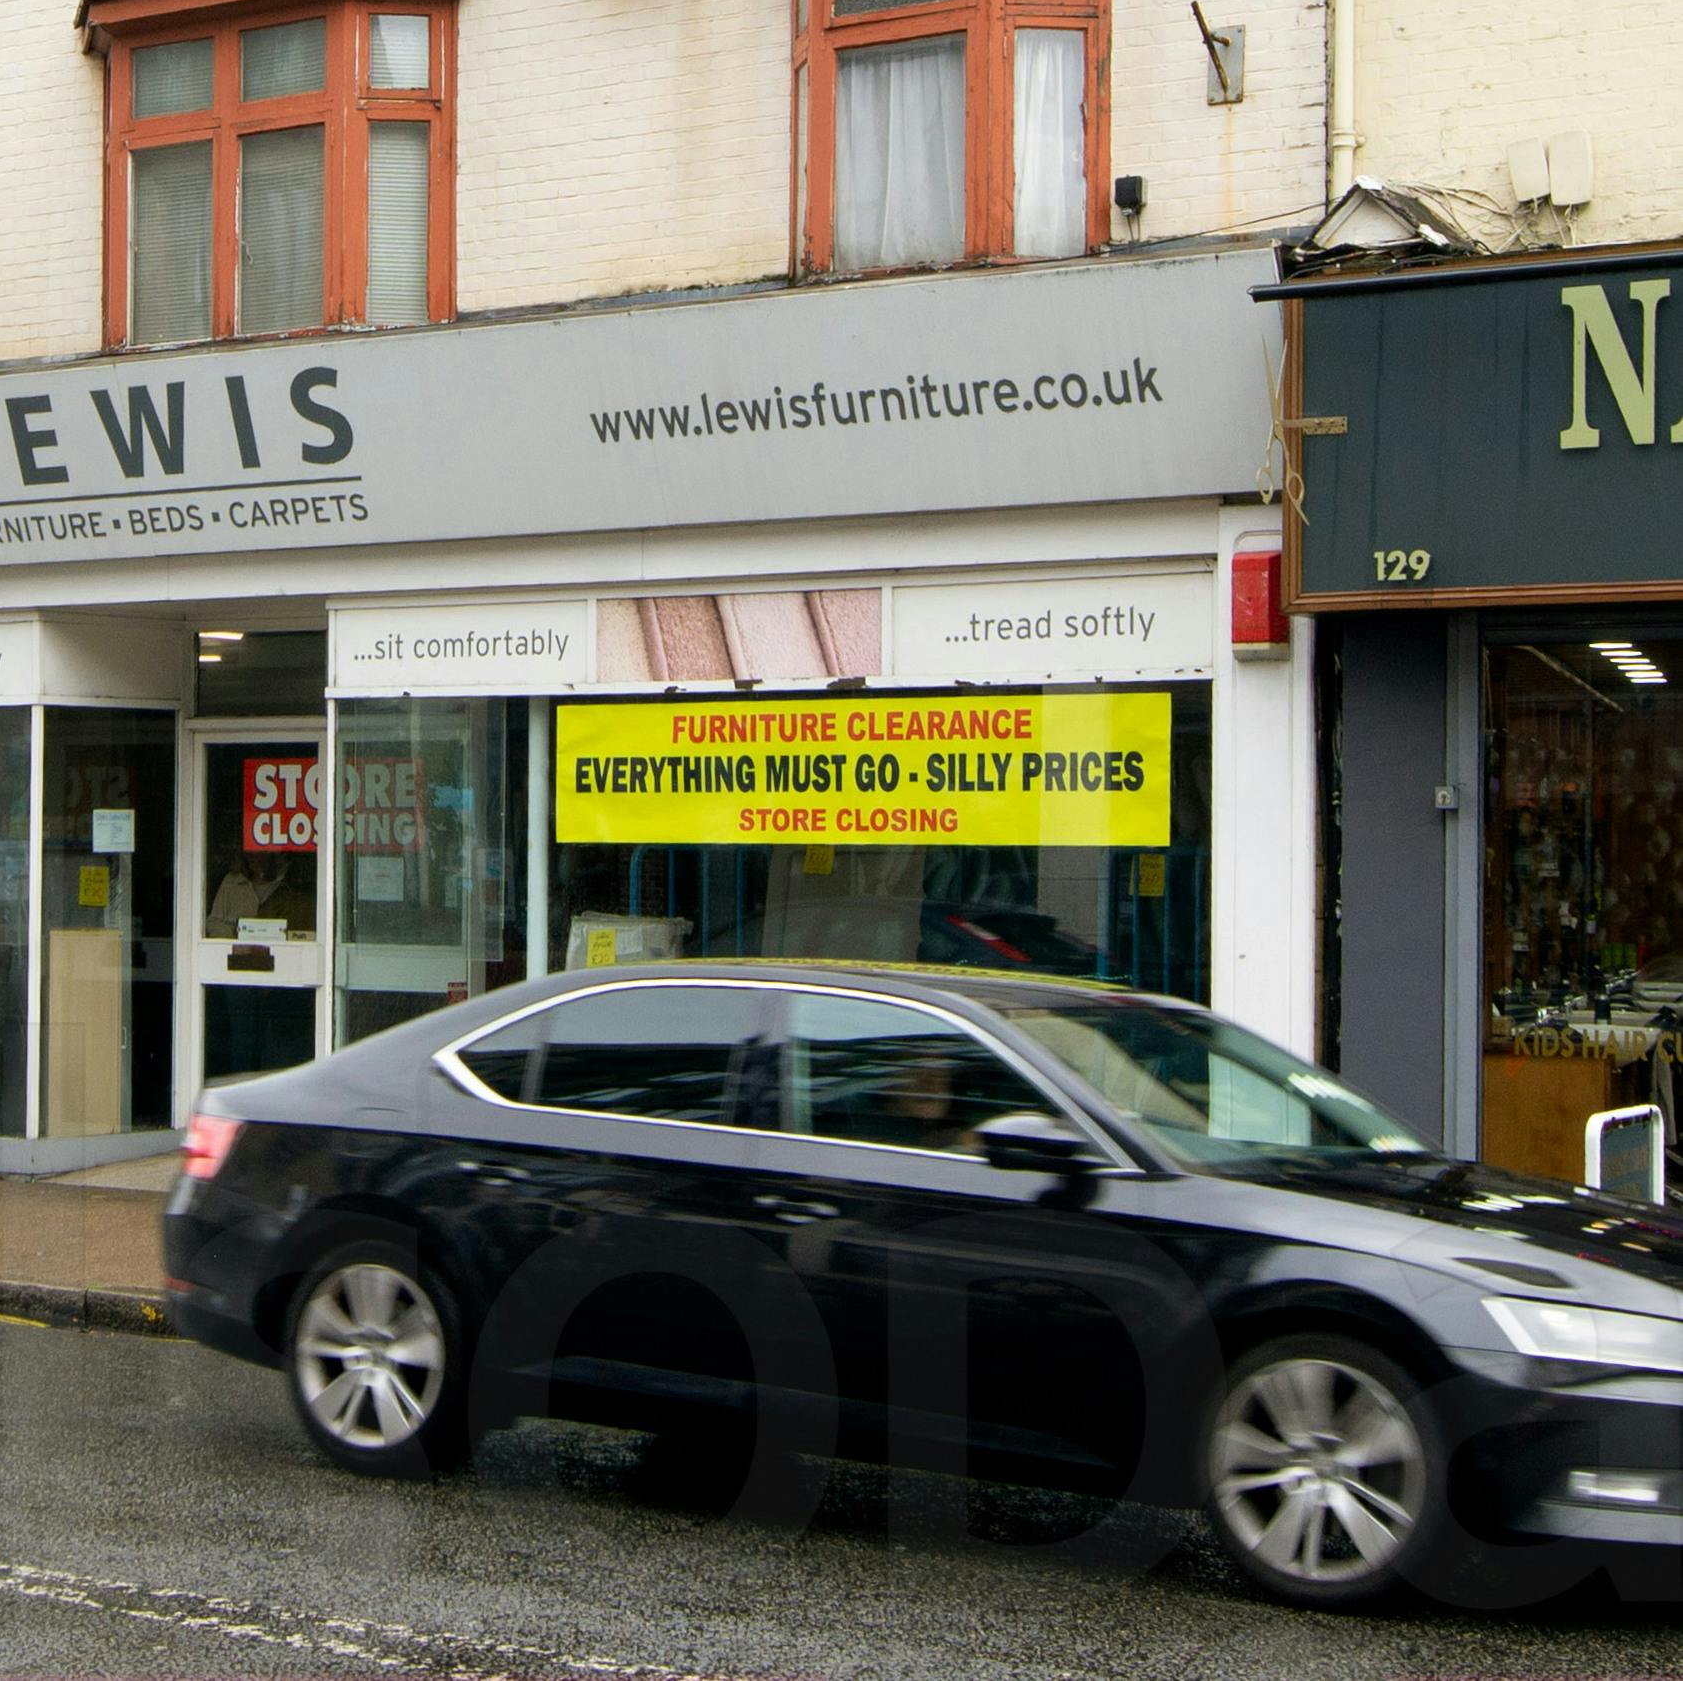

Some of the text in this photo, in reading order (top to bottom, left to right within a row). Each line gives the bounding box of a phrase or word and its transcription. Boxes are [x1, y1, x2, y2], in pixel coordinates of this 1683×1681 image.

[591, 357, 1163, 444] www.lewisfurniture.co.uk
[131, 504, 204, 536] BEDS
[229, 493, 369, 529] CARPETS
[1374, 549, 1431, 581] 129
[944, 605, 1156, 645] ...tread softly
[354, 627, 570, 663] ...sit comfortably
[672, 709, 1032, 744] FURNITURE CLEARANCE
[253, 763, 418, 809] STORE
[575, 755, 756, 793] EVERYTHING
[765, 754, 846, 792] MUST
[854, 753, 899, 791] GO
[925, 753, 1013, 792] SILLY
[1021, 751, 1145, 790] PRICES
[252, 812, 416, 846] CLOSING
[738, 807, 959, 833] STORE CLOSING
[1513, 1026, 1575, 1058] KIDS
[1581, 1029, 1648, 1062] HAIR
